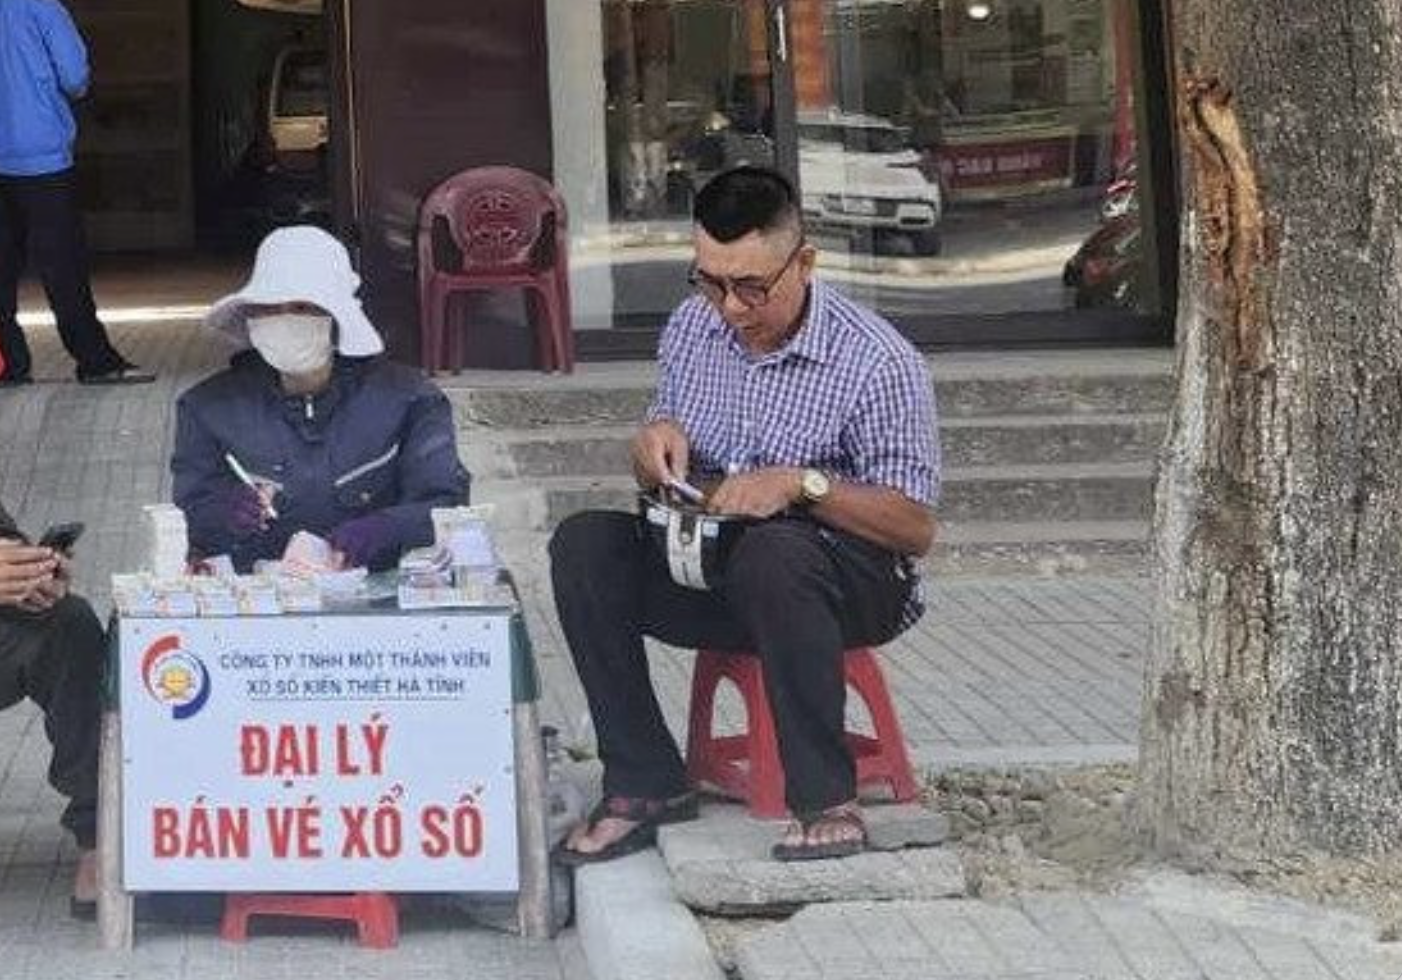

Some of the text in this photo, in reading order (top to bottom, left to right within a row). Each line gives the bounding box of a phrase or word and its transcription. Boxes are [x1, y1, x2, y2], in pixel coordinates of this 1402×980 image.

[220, 647, 491, 671] CÔNG TY TNHH MỘT THÀNH VIÊN
[239, 711, 389, 789] ĐẠI LÝ
[152, 782, 485, 858] BÁN VÉ XỔ SỐ
